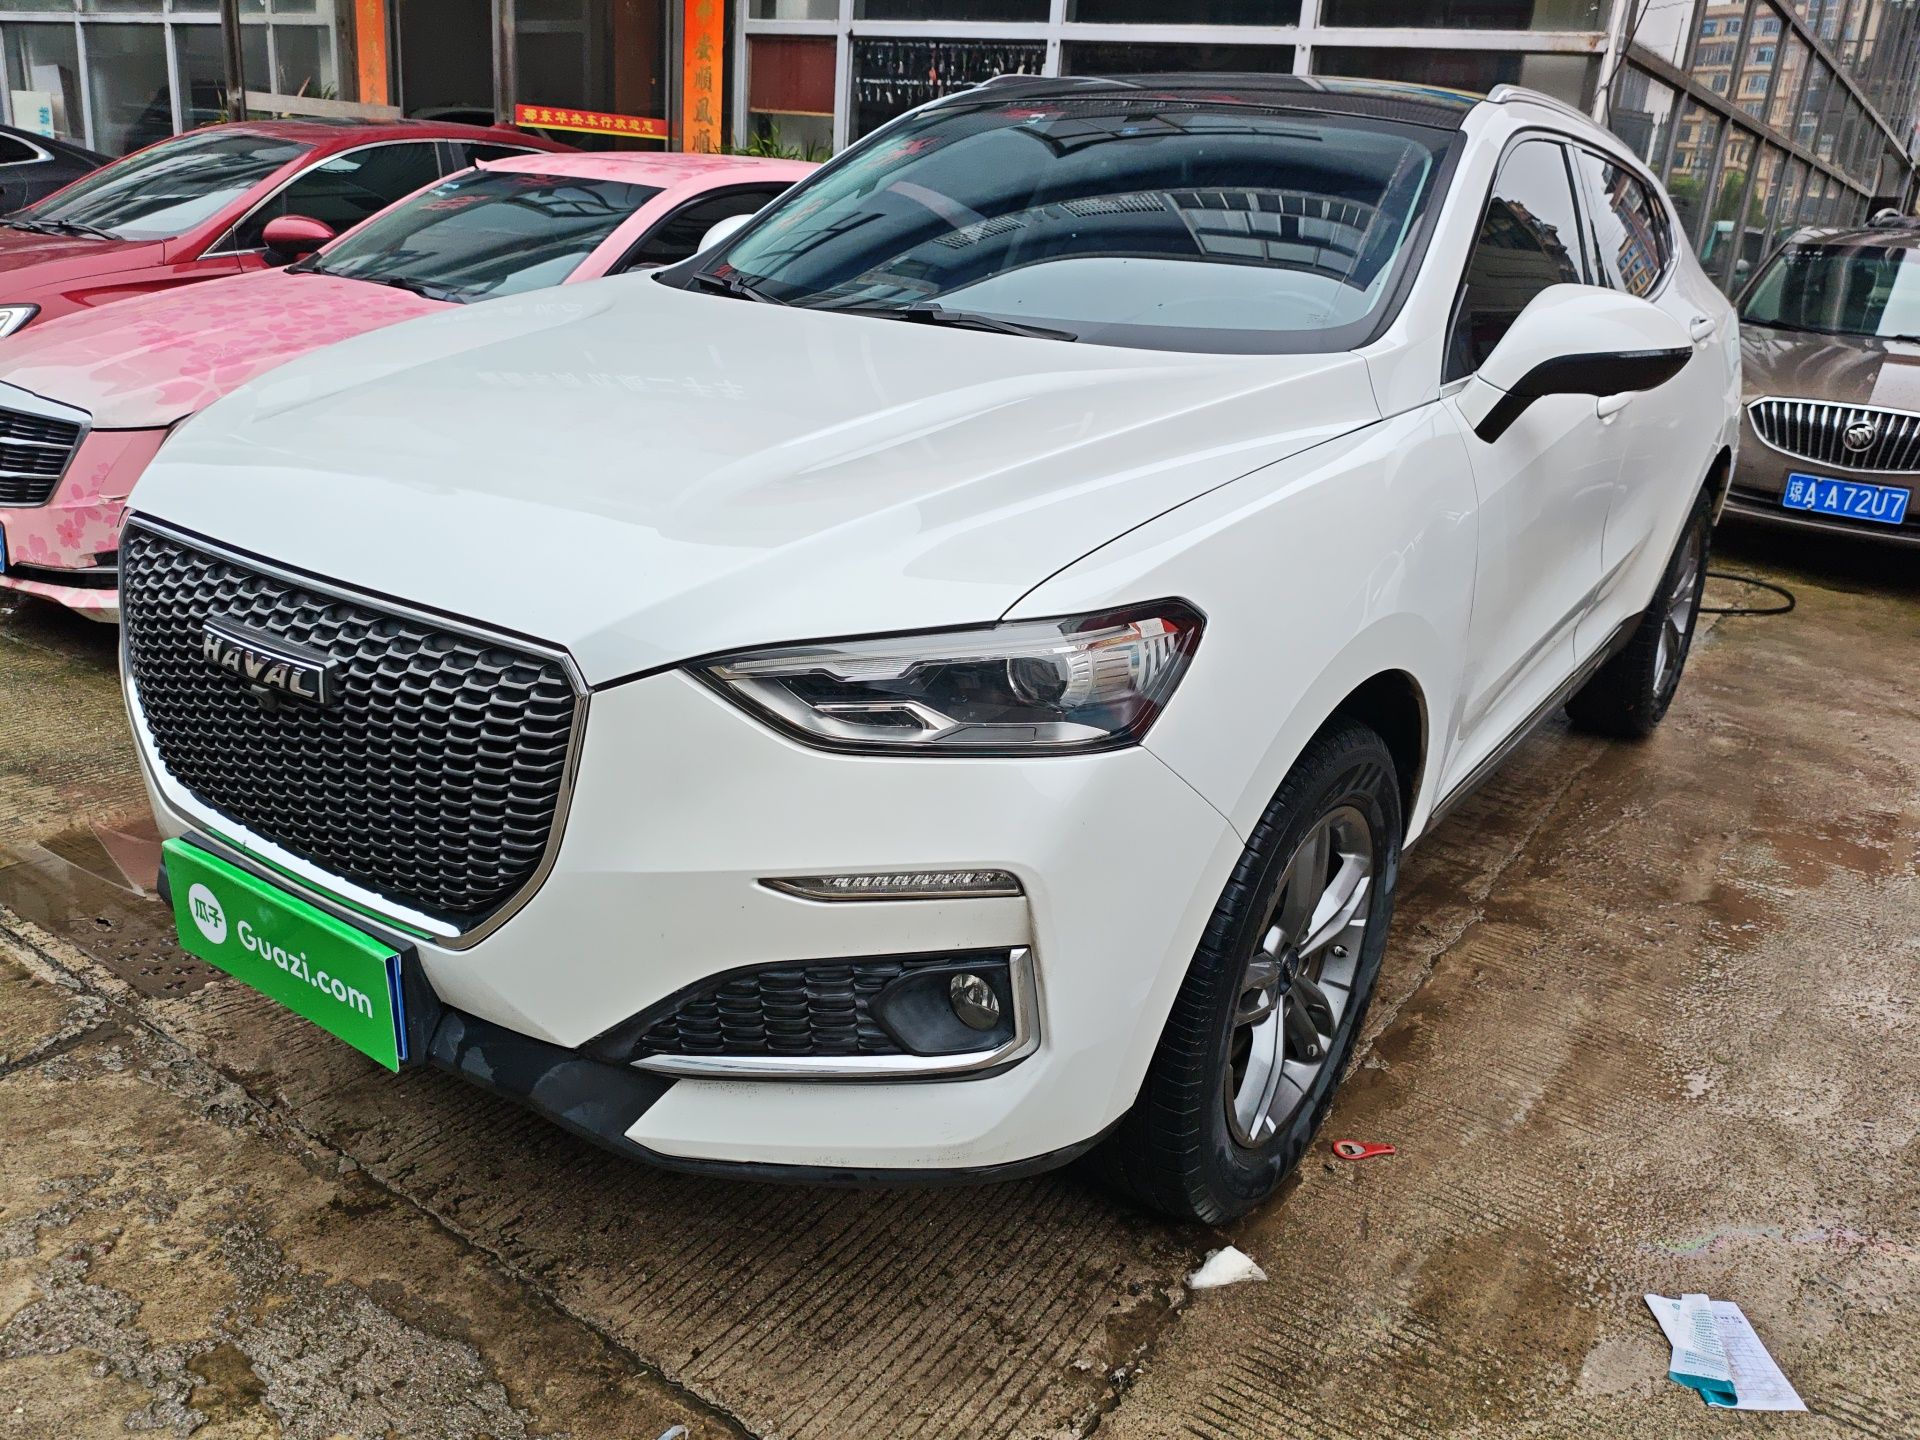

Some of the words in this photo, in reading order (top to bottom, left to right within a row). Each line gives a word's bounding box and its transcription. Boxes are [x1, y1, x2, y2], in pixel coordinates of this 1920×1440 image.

[203, 633, 316, 698] HAVAL
[194, 897, 223, 929] 瓜子
[237, 919, 374, 1019] Guazi.com
